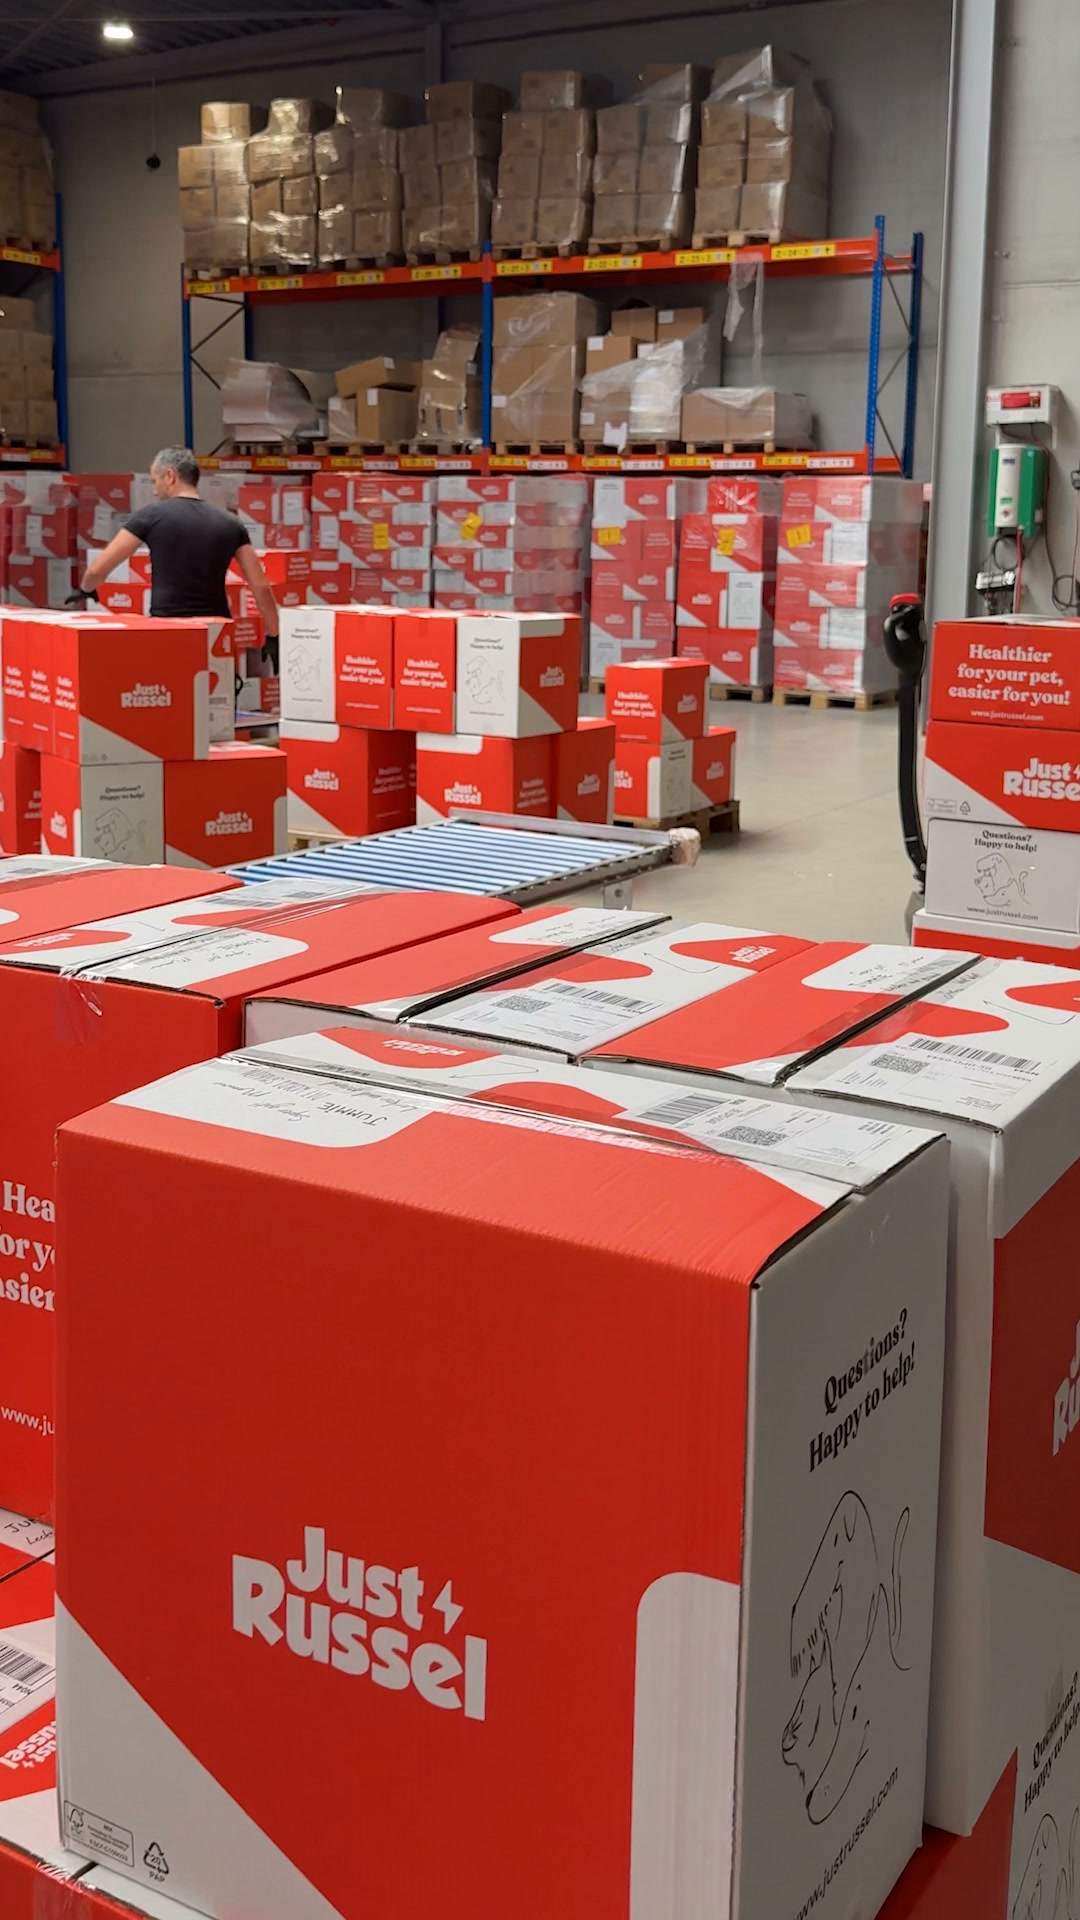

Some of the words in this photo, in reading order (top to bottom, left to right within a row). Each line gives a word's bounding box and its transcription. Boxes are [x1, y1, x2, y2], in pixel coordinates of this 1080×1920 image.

[969, 644, 1052, 662] Healthier
[957, 664, 985, 678] for
[985, 669, 1028, 684] your
[1029, 672, 1064, 687] pet,
[120, 691, 171, 708] Russel
[133, 682, 160, 696] Just
[948, 684, 1000, 700] easier
[1002, 687, 1029, 702] for
[1030, 690, 1070, 706] you!
[1023, 758, 1071, 780] Just
[444, 788, 482, 805] Russel
[452, 782, 472, 793] Just
[205, 818, 253, 836] Russel
[216, 811, 242, 824] Just
[974, 838, 1002, 849] Happy
[1015, 842, 1037, 852] help!
[982, 830, 1032, 842] Questions?
[0, 1234, 30, 1259] or
[32, 1241, 55, 1272] y
[824, 1308, 907, 1416] Questions?
[809, 1402, 862, 1472] Happy
[865, 1387, 880, 1417] to
[882, 1340, 915, 1400] help!
[4, 1518, 36, 1533] JU
[286, 1525, 424, 1631] Just
[232, 1554, 487, 1721] Russel
[1033, 1671, 1078, 1770] Questions?
[1024, 1752, 1053, 1814] Happy
[1054, 1736, 1062, 1759] to
[794, 1767, 898, 1920] ww.justrussel.com
